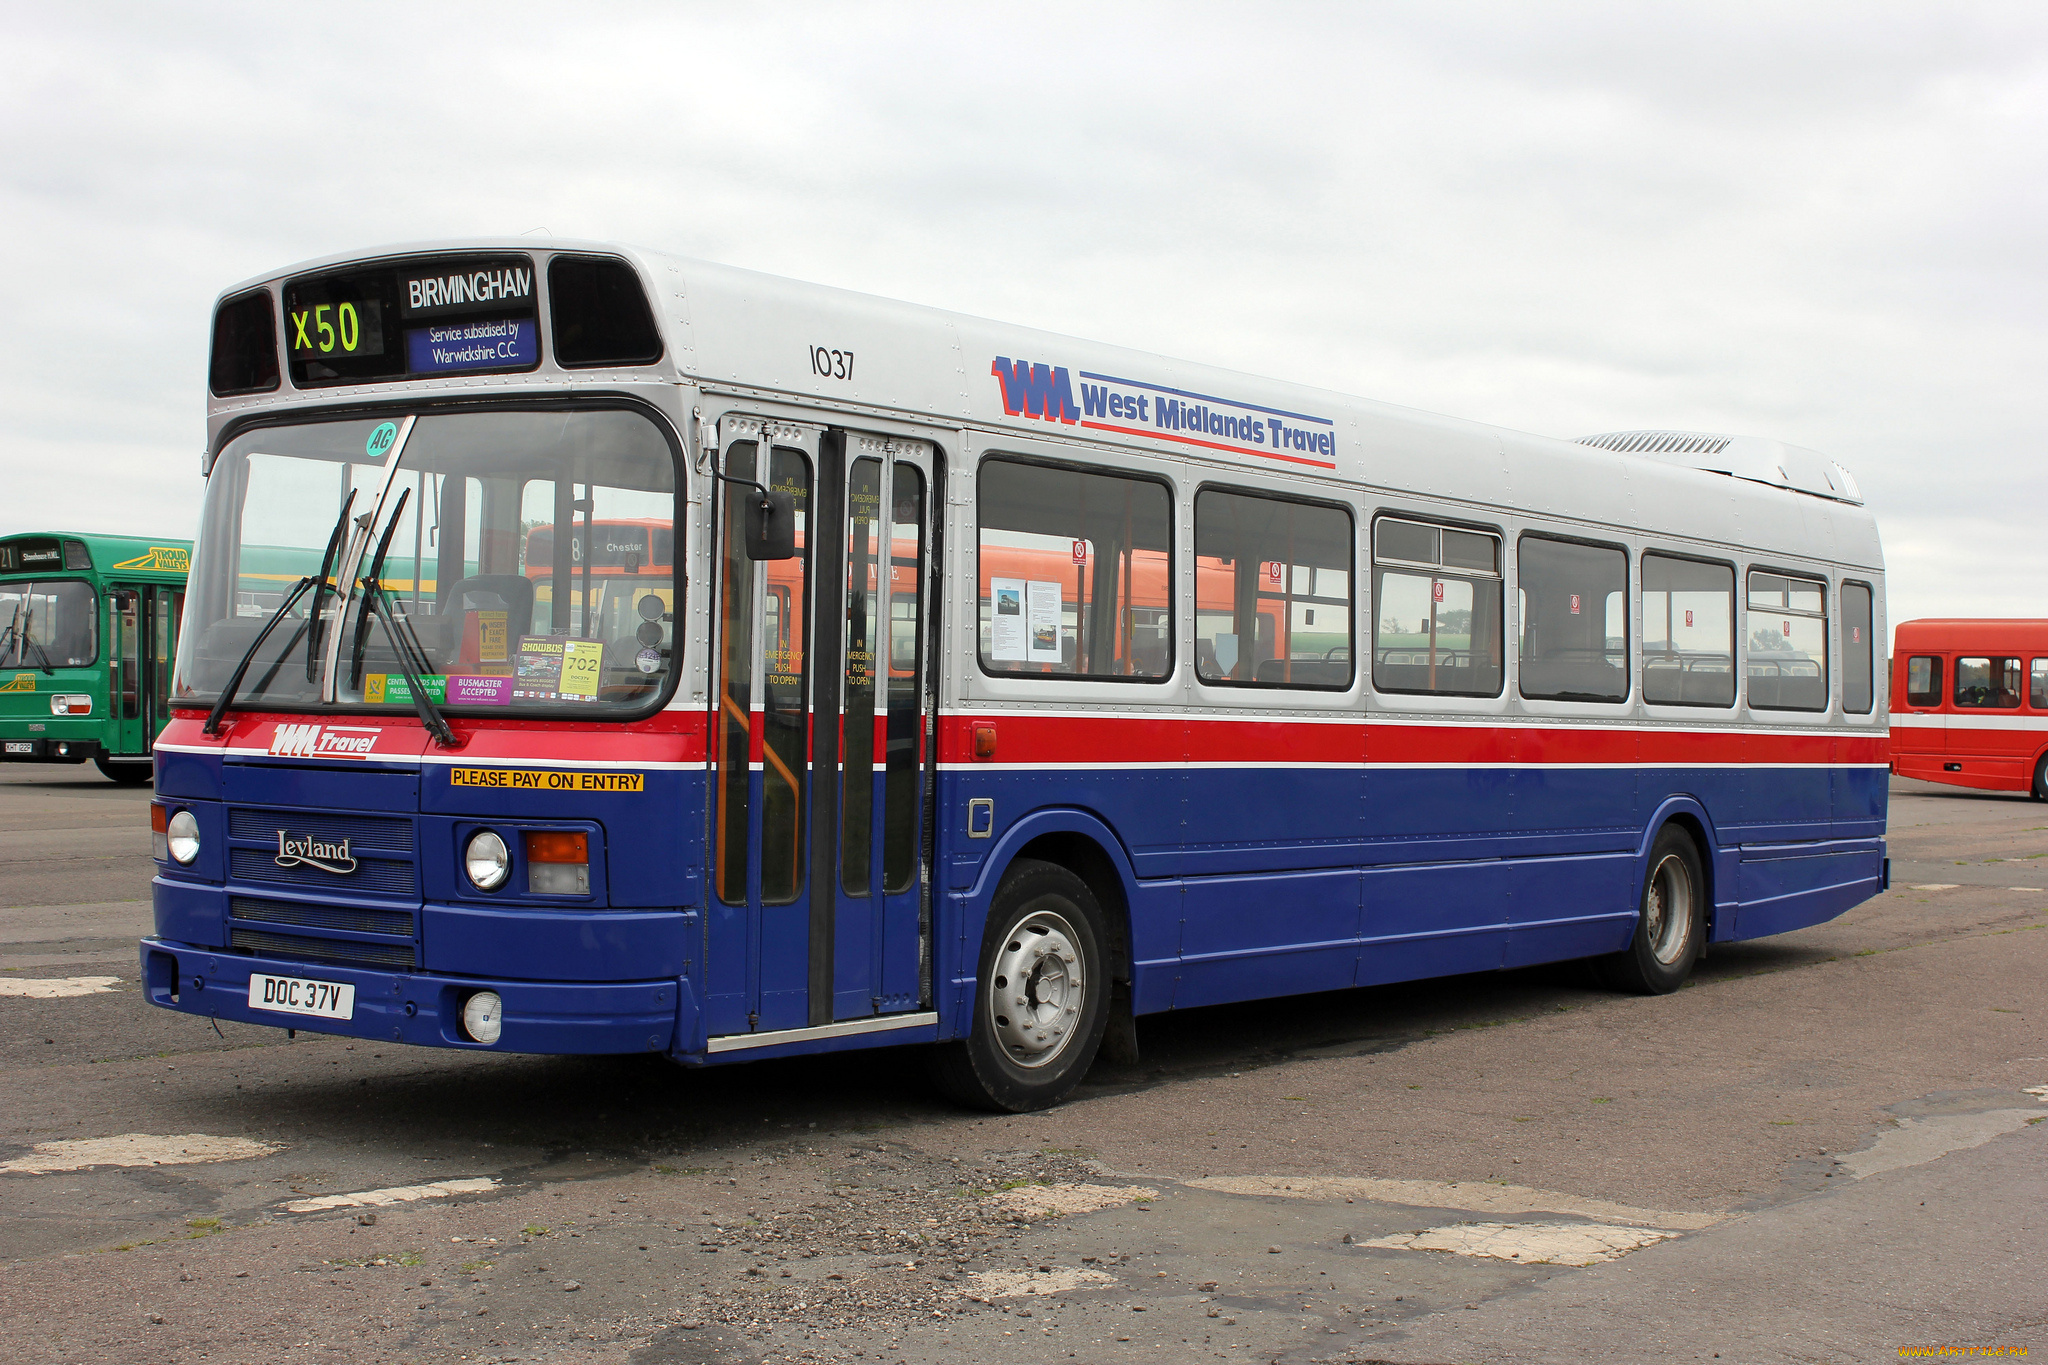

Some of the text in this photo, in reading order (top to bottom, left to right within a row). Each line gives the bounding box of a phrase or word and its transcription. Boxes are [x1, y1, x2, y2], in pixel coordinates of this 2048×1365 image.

[409, 267, 531, 308] BIRMINGHAM
[430, 320, 519, 342] Service subsidised by
[432, 341, 519, 364] Warwickshire C.C.
[809, 344, 854, 381] 1037
[1080, 383, 1336, 456] West Midlands Travel
[370, 428, 393, 449] AG
[606, 542, 642, 552] Chester
[158, 559, 187, 569] VALLEYS
[521, 642, 563, 653] SHOWBUS
[780, 640, 788, 648] IN
[857, 639, 863, 647] IN
[765, 650, 804, 660] EMERGENCY
[568, 657, 598, 672] 702
[774, 663, 791, 672] PUSH
[852, 664, 866, 673] PUSH
[458, 679, 502, 688] BUSMASTER
[769, 675, 798, 685] TO OPEN
[848, 676, 871, 685] TO OPEN
[460, 688, 497, 696] ACCEPTED
[318, 732, 379, 752] Travel
[453, 769, 641, 790] PLEASE PAY ON ENTRY
[275, 830, 356, 873] Leyland
[263, 978, 341, 1011] DOC 37V
